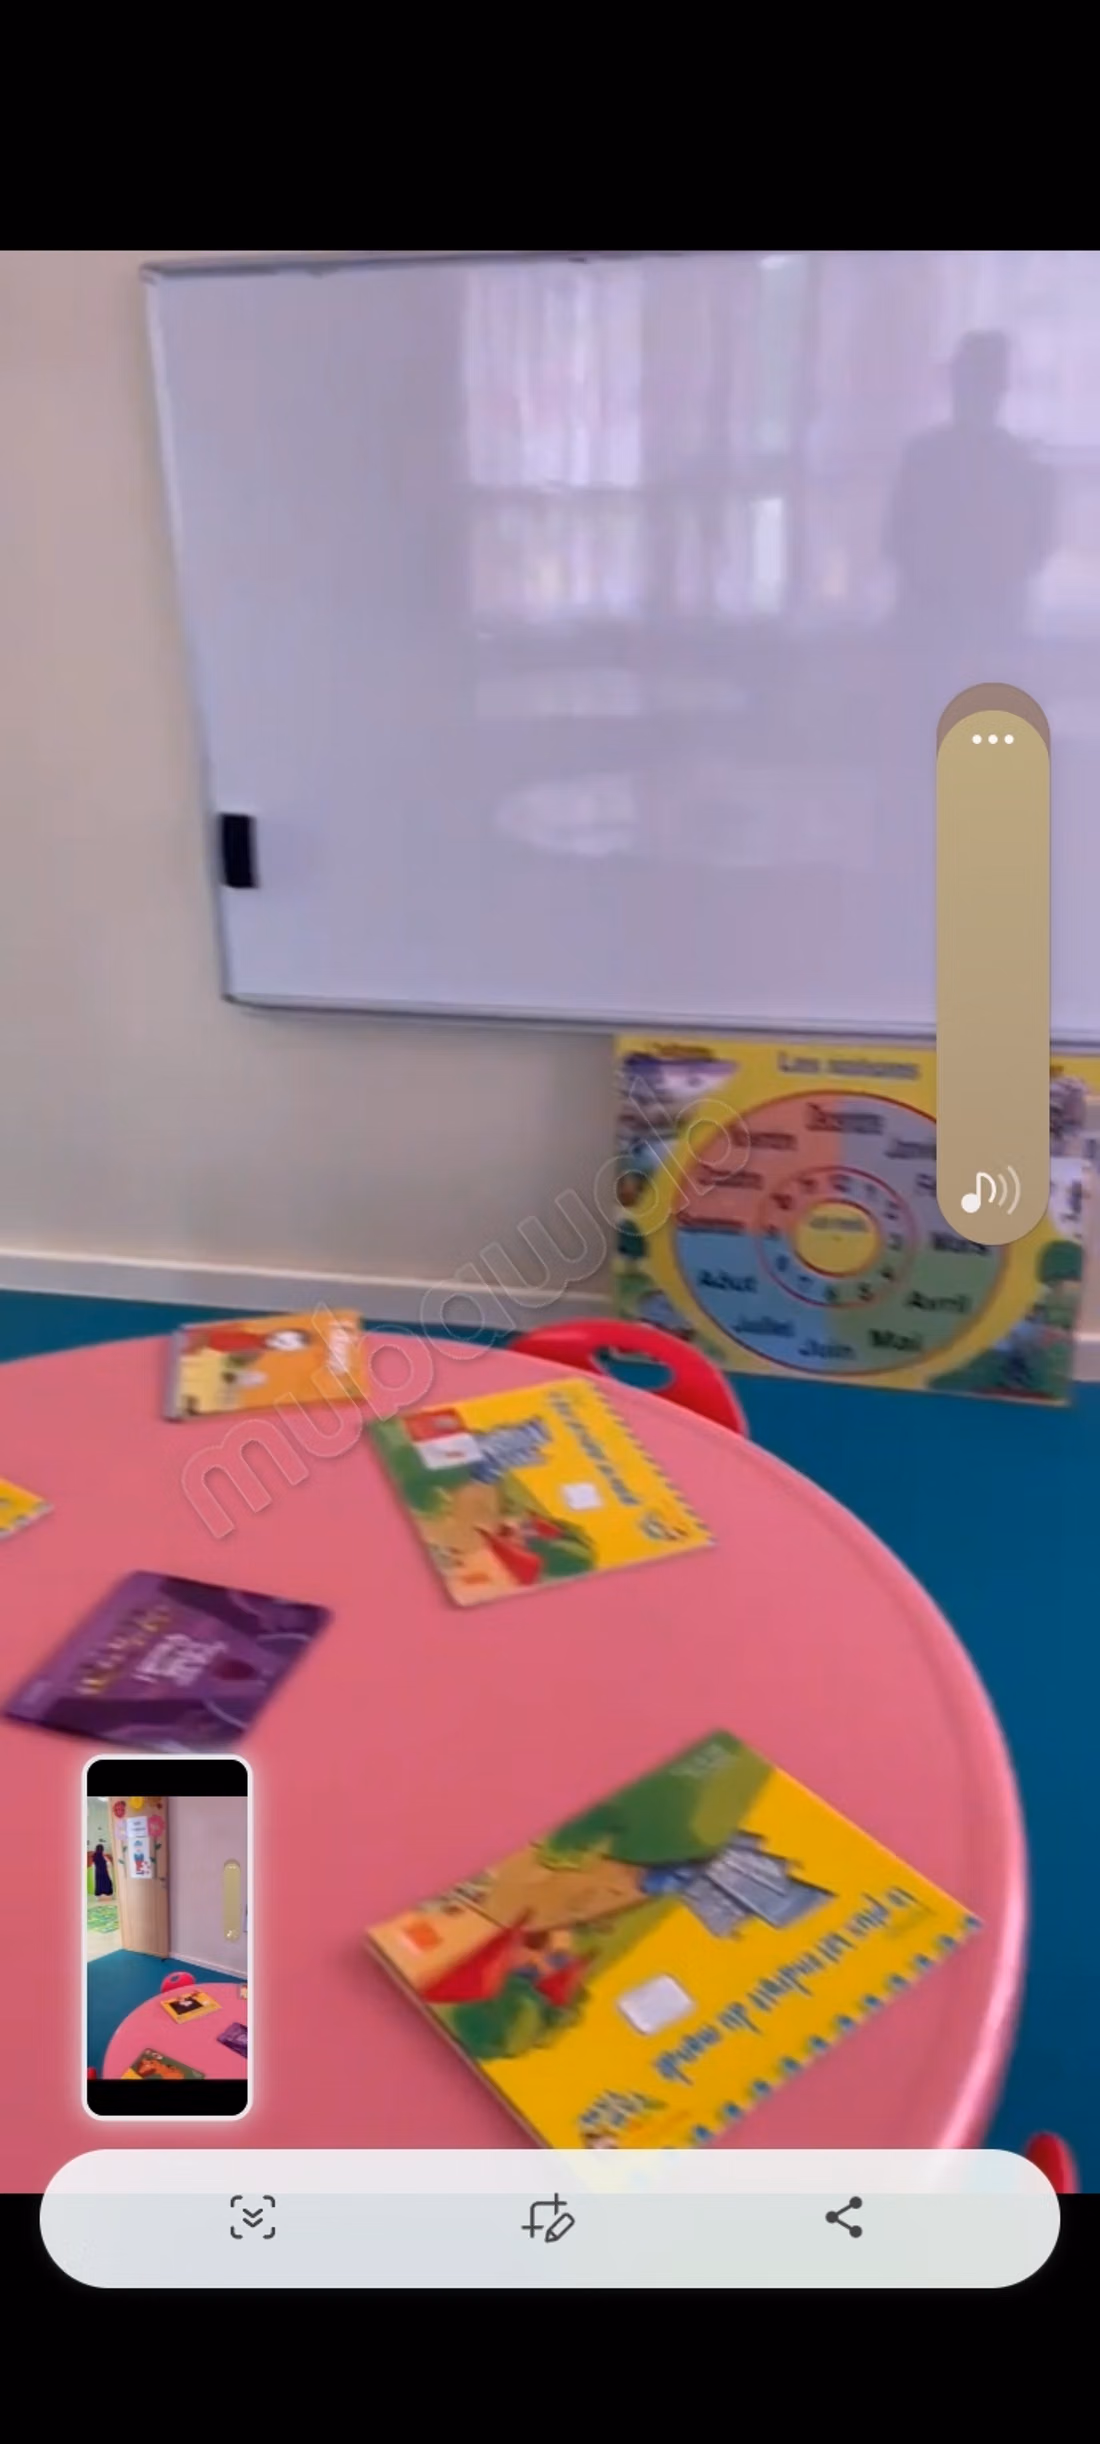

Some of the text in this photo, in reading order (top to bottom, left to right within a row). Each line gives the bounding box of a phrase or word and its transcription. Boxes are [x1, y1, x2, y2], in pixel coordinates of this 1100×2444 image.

[905, 1290, 973, 1313] Avril
[869, 1328, 924, 1352] Mai
[715, 2001, 764, 2035] du
[653, 2024, 723, 2088] monde
